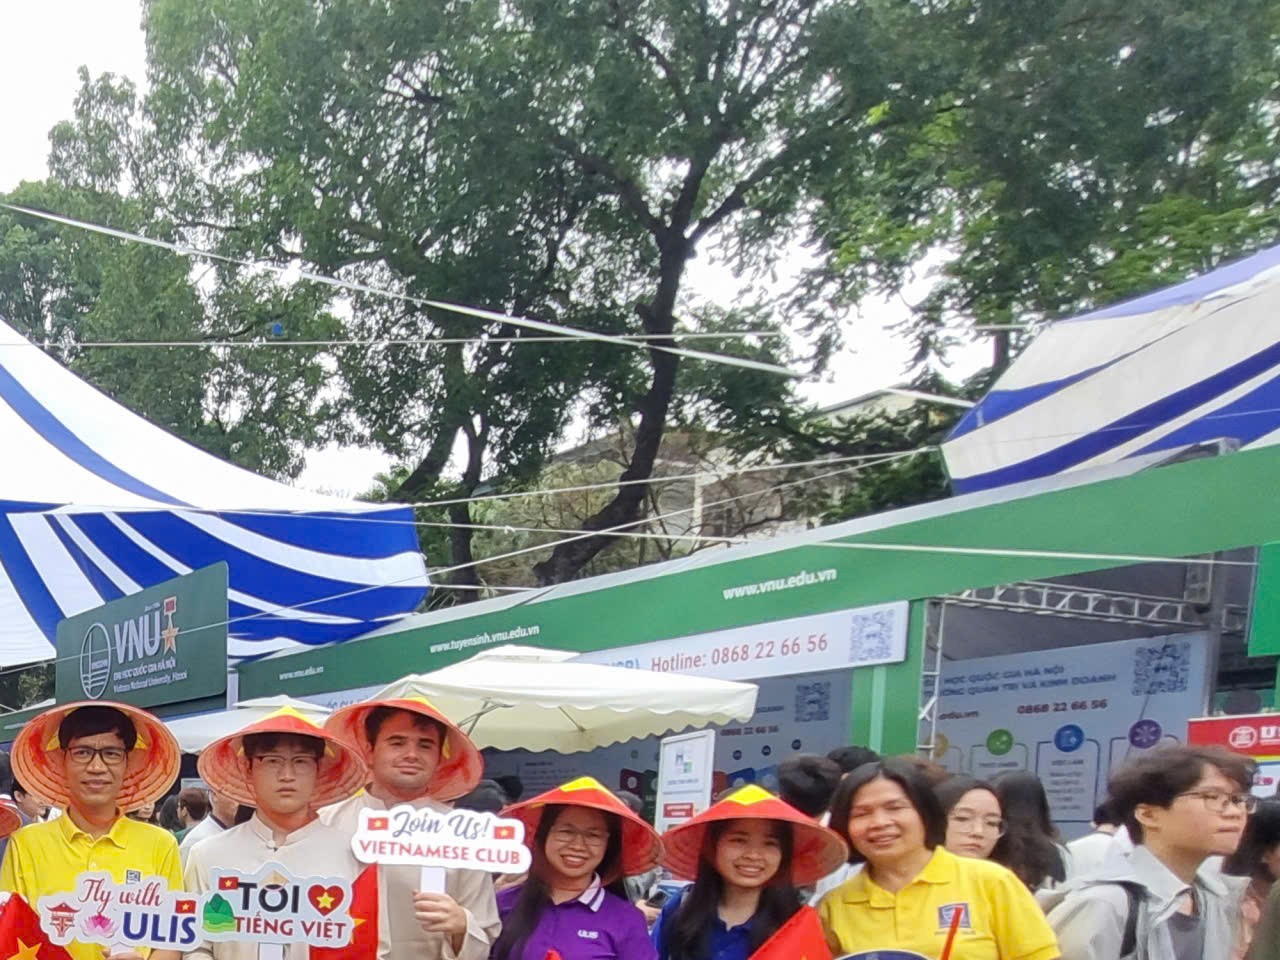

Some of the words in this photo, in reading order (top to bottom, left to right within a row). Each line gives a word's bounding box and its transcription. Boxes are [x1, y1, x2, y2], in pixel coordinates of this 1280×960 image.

[722, 568, 838, 601] www.vnu.edu.vn
[114, 610, 162, 665] VNU
[429, 624, 541, 654] www.tuyensinh.vnu.edu.vn
[651, 652, 706, 673] Hotline:
[711, 645, 749, 665] 0868
[755, 640, 773, 660] 22
[780, 636, 801, 656] 66
[807, 633, 828, 652] 56
[391, 810, 444, 838] Join
[447, 814, 491, 840] Us!
[358, 839, 470, 861] VIETNAMESE
[475, 847, 521, 865] CLUB
[77, 878, 113, 914] Fly
[119, 881, 163, 908] with
[122, 911, 197, 945] ULIS
[234, 910, 294, 937] TIẾNG
[301, 918, 347, 942] VIỆT
[577, 929, 600, 940] ULIS
